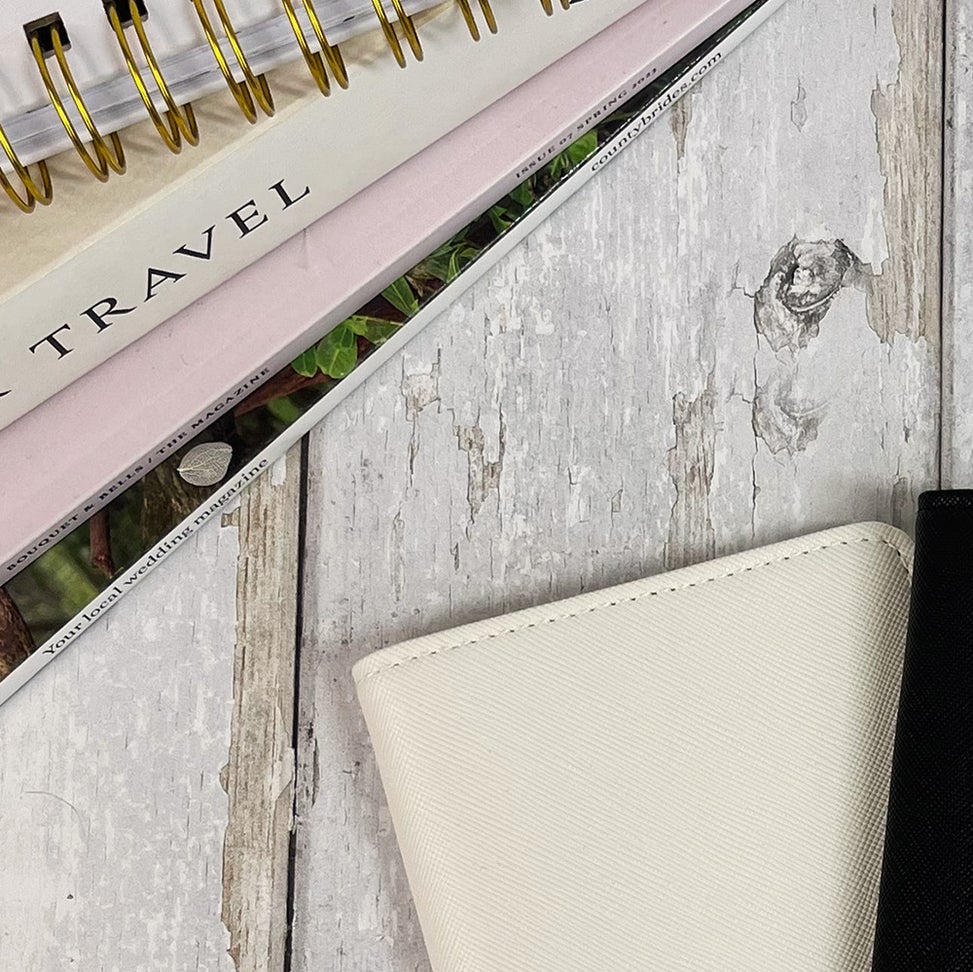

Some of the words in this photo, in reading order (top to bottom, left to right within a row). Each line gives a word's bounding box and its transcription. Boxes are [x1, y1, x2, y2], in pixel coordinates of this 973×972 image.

[515, 145, 556, 179] ISSUE
[576, 89, 628, 131] SPRING
[591, 51, 723, 172] countybrides.com
[28, 178, 311, 361] TRAVEL
[6, 513, 80, 572] BOUQUET
[98, 464, 144, 500] BELLS
[155, 431, 188, 455] THE
[191, 366, 270, 430] MAGAZINE
[42, 621, 83, 656] Your
[82, 586, 123, 622] local
[123, 525, 194, 586] wedding
[193, 458, 268, 526] magazine
